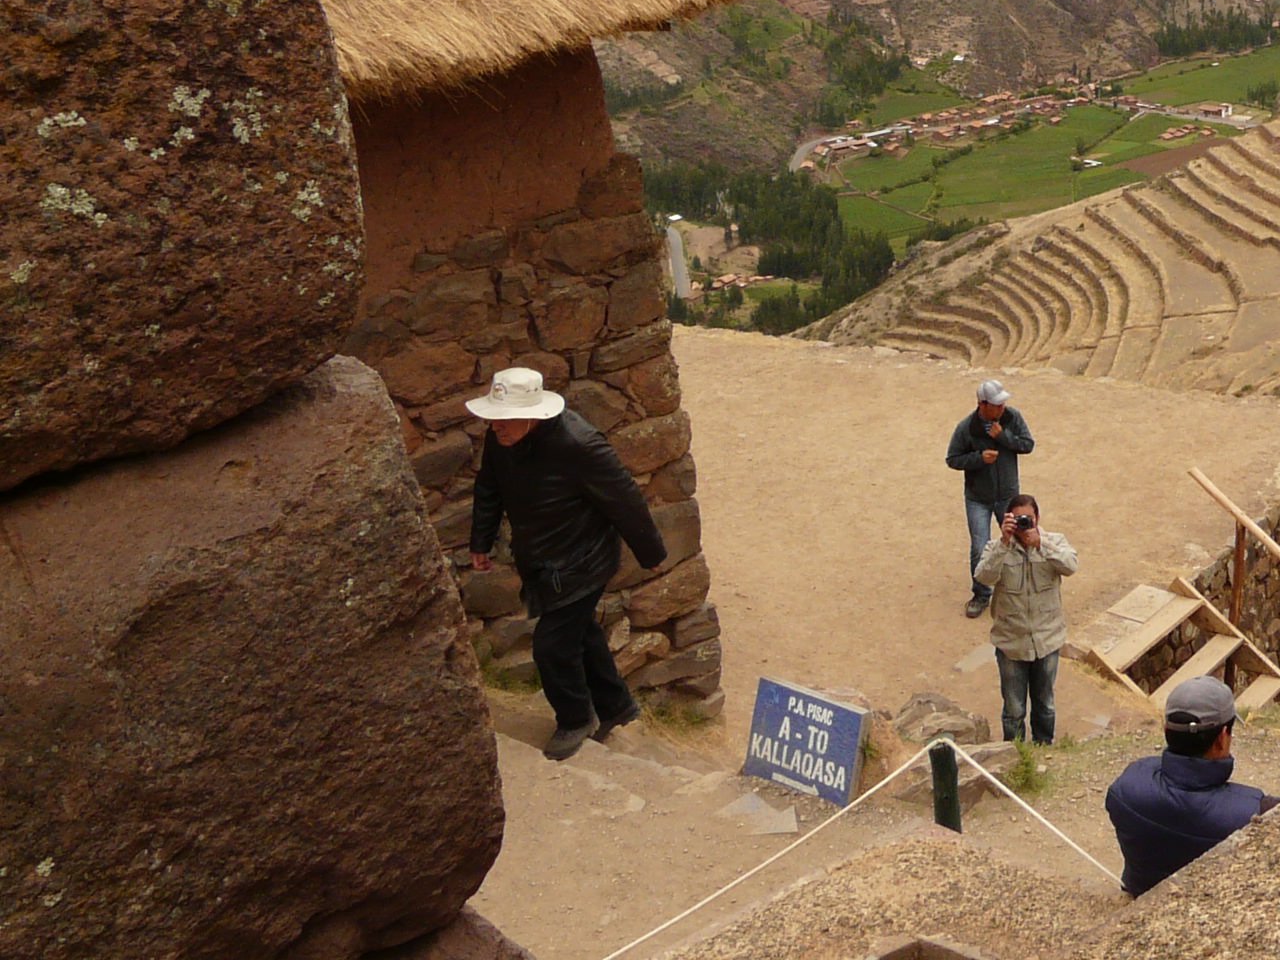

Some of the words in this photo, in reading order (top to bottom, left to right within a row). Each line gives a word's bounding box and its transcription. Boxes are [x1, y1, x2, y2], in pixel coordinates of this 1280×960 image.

[788, 696, 805, 717] P.A.
[807, 703, 834, 726] PISAC
[778, 716, 791, 741] A
[808, 726, 829, 755] TO
[751, 733, 845, 792] KALLAQASA
